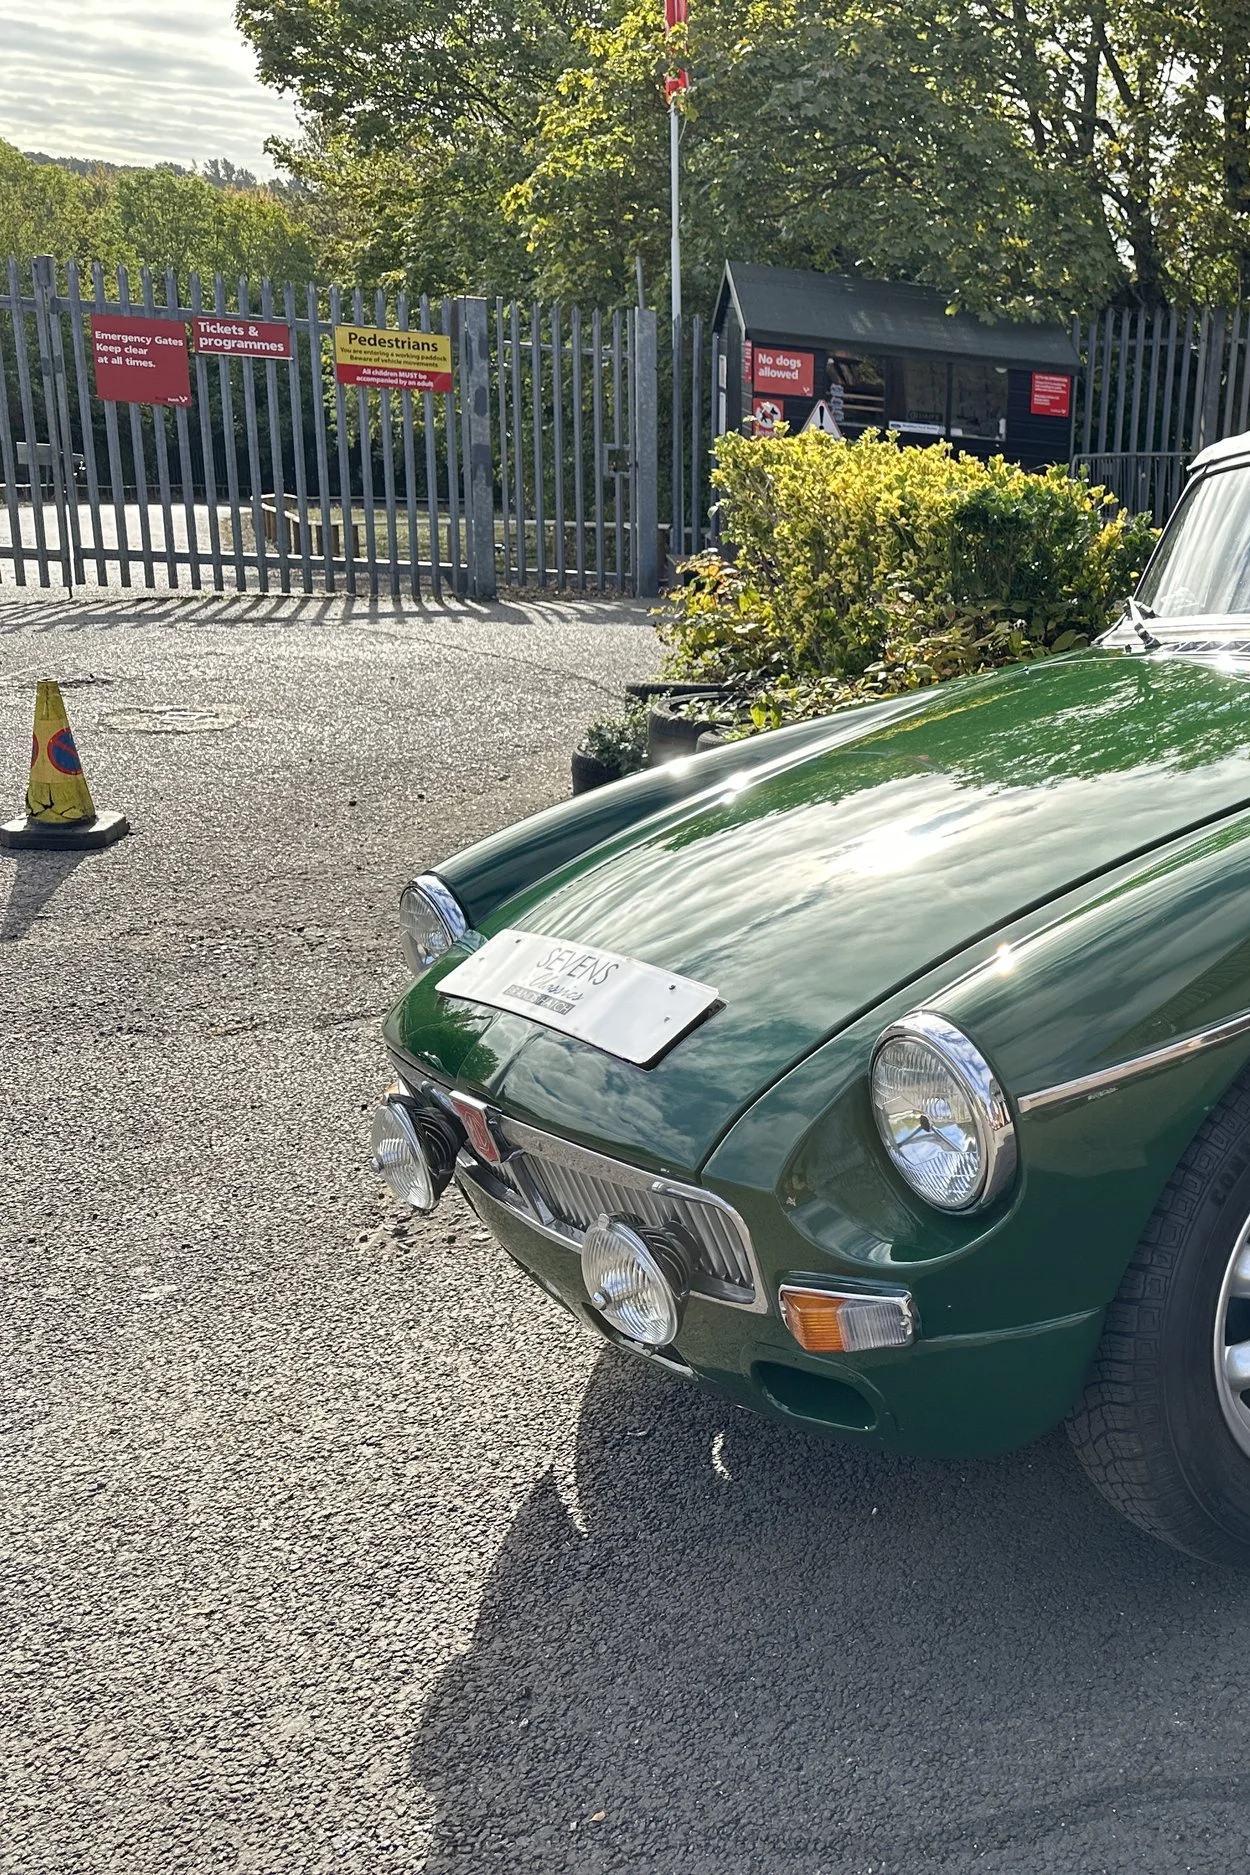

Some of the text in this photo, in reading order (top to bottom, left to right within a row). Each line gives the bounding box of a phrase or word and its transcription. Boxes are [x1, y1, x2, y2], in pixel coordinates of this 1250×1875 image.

[198, 321, 259, 337] Tickets &
[95, 330, 184, 347] Emergency Gates
[198, 337, 285, 352] programmes
[348, 332, 438, 352] Pedestrians
[96, 342, 149, 355] Keep clear
[363, 349, 390, 358] entering
[395, 352, 421, 361] working
[421, 353, 448, 363] paddock
[97, 355, 156, 368] at all times.
[350, 354, 373, 362] Beware
[381, 357, 402, 365] vehicle
[403, 360, 438, 368] movements
[758, 353, 802, 370] No dogs
[372, 369, 398, 378] children
[398, 371, 418, 380] MUST
[758, 366, 799, 381] allowed
[356, 375, 399, 386] accompanied
[399, 378, 407, 387] by
[417, 379, 434, 388] adult
[537, 947, 619, 985] SEVENS
[528, 971, 584, 1001] Classics
[538, 994, 572, 1015] HATCH
